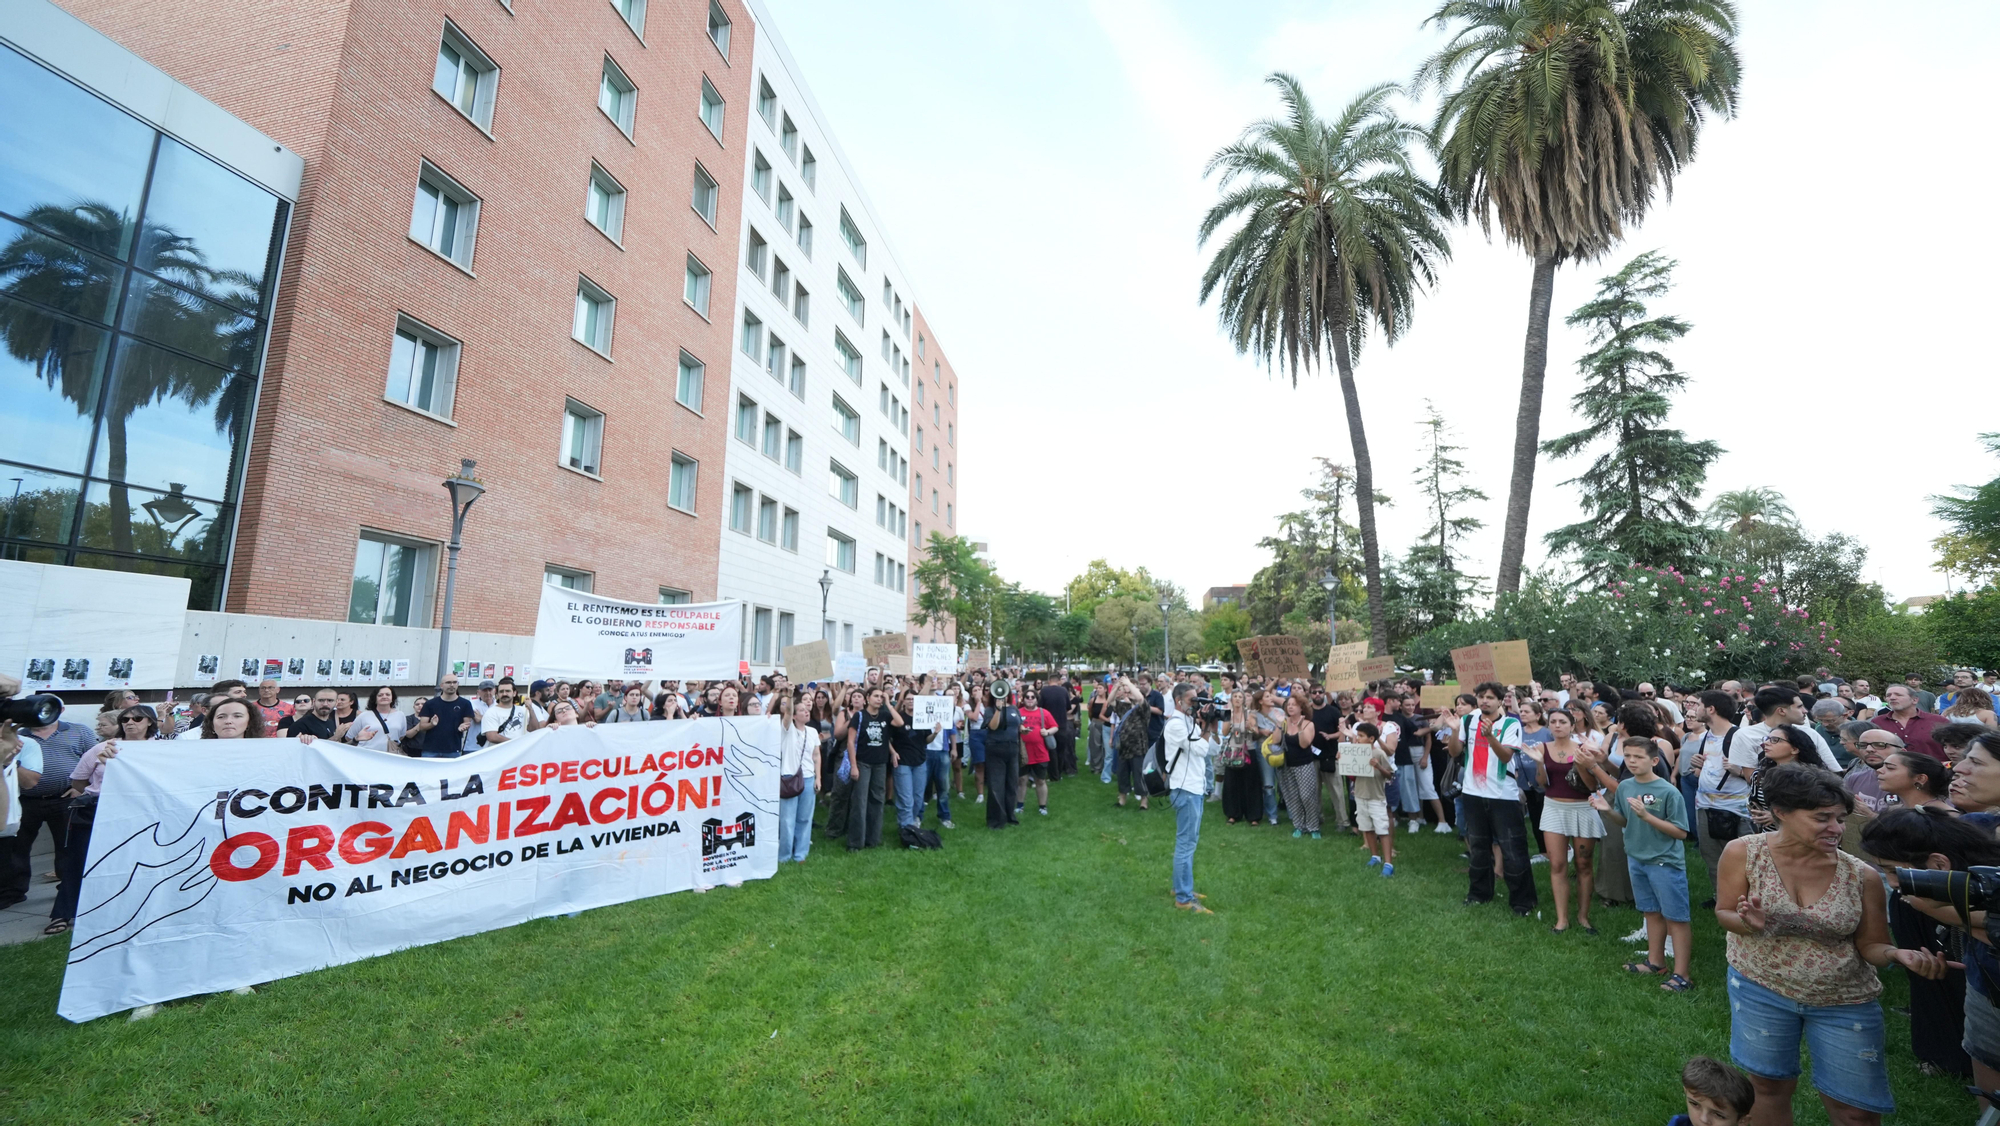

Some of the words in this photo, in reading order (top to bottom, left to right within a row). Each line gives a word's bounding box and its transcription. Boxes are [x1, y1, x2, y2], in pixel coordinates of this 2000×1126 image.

[567, 602, 579, 611] EL
[582, 604, 638, 616] RENTISMO
[641, 609, 653, 617] ES
[655, 609, 667, 618] EL
[670, 610, 721, 620] CULPABLE
[571, 615, 583, 624] EL
[586, 616, 642, 628] GOBIERNO
[645, 621, 716, 631] RESPONSABLE
[1260, 638, 1269, 646] ES
[927, 645, 949, 653] BONOS
[1261, 647, 1278, 657] GENTE
[926, 653, 952, 661] PARCHES
[1278, 664, 1302, 673] GENTE
[1329, 671, 1357, 681] VUESTRO
[1340, 746, 1371, 756] DERECHO
[1340, 764, 1372, 774] TECHO
[214, 782, 426, 820] ¡CONTRA
[440, 774, 484, 801] LA
[498, 743, 724, 792] ESPECULACIÓN
[209, 772, 722, 882] ORGANIZACIÓN!
[287, 882, 336, 905] NO
[345, 874, 382, 897] AL
[391, 850, 514, 888] NEGOCIO
[521, 843, 549, 862] DE
[556, 837, 584, 855] LA
[590, 820, 681, 849] VIVIENDA
